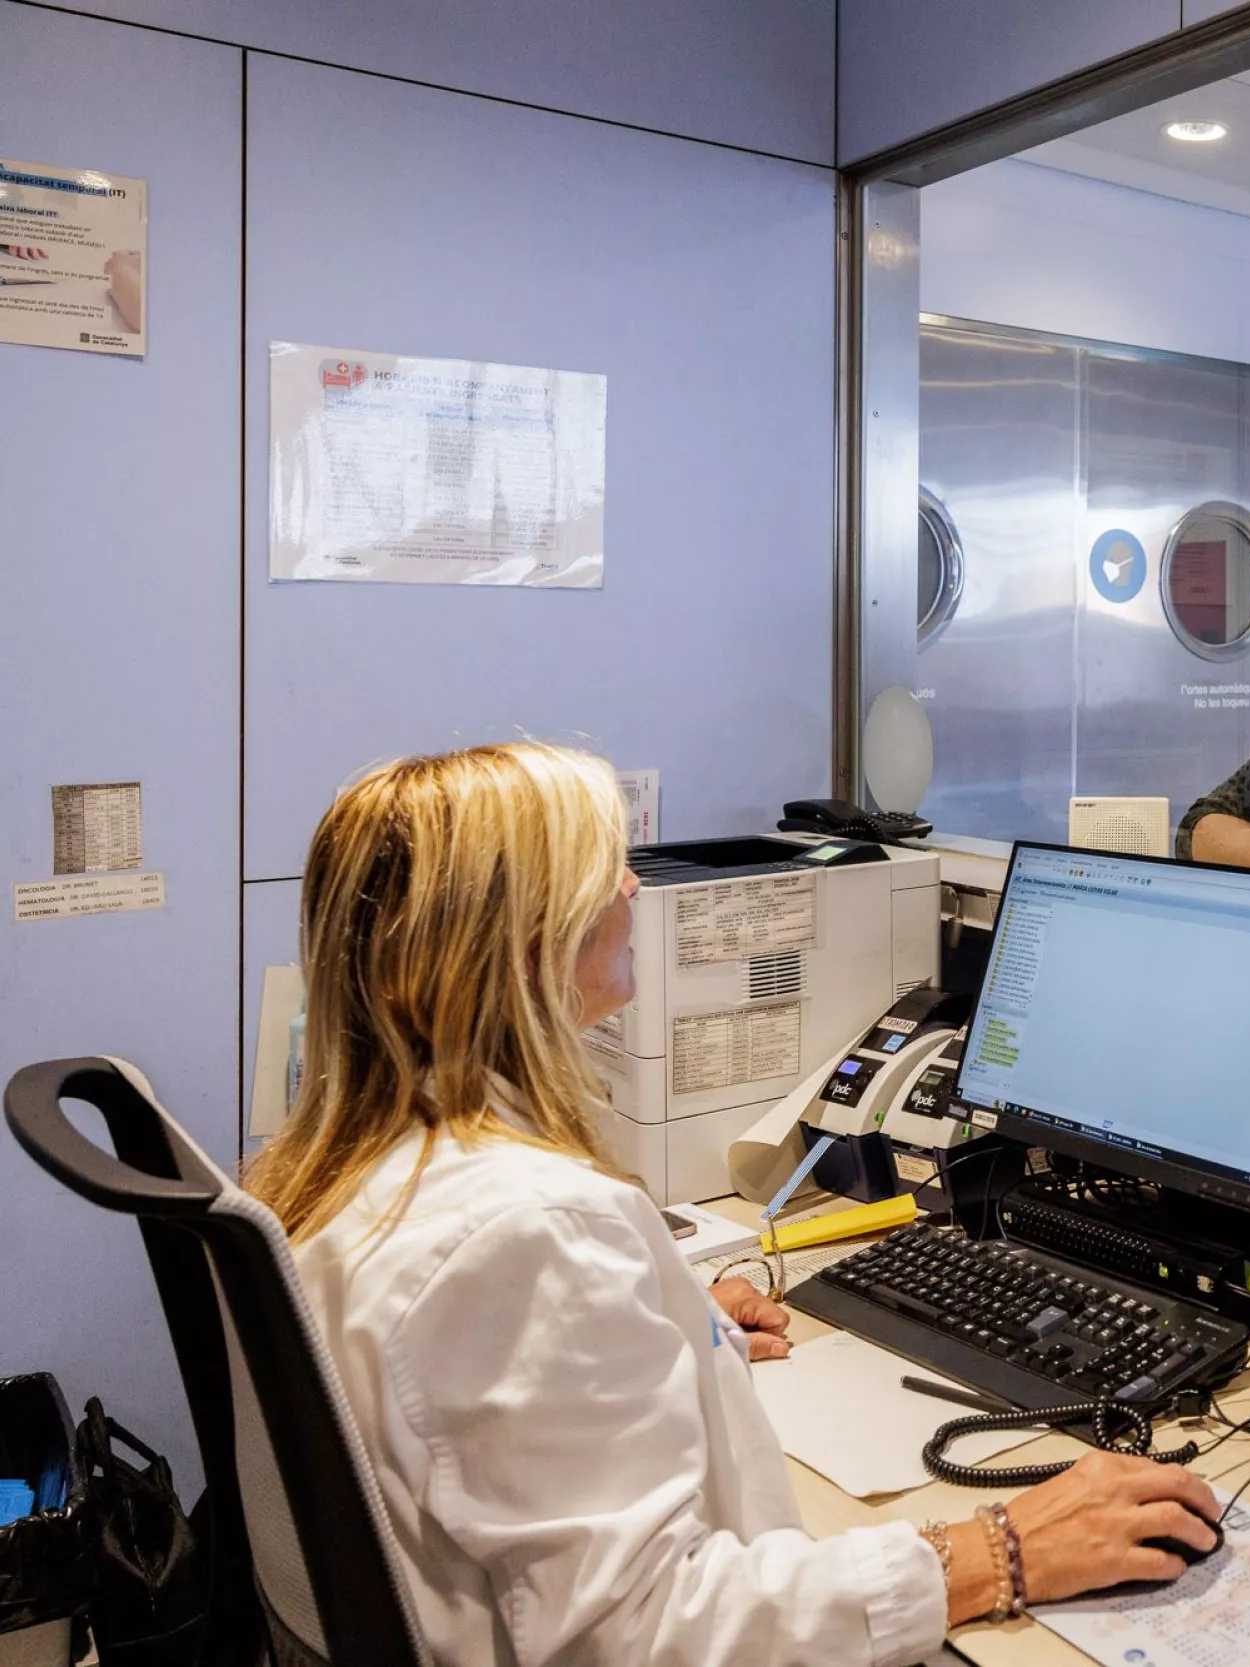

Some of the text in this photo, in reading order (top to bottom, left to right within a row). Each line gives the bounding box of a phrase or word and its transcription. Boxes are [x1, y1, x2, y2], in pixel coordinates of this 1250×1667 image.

[109, 188, 126, 199] (IT)
[1181, 684, 1208, 695] Portes
[1194, 698, 1250, 709] No les toqueu
[18, 885, 56, 895] ONCOLOGIA
[18, 895, 65, 906] HEMATOLOGIA
[18, 907, 59, 918] OBSTETRICIA
[832, 1083, 852, 1098] pdc
[915, 1095, 936, 1110] pdc
